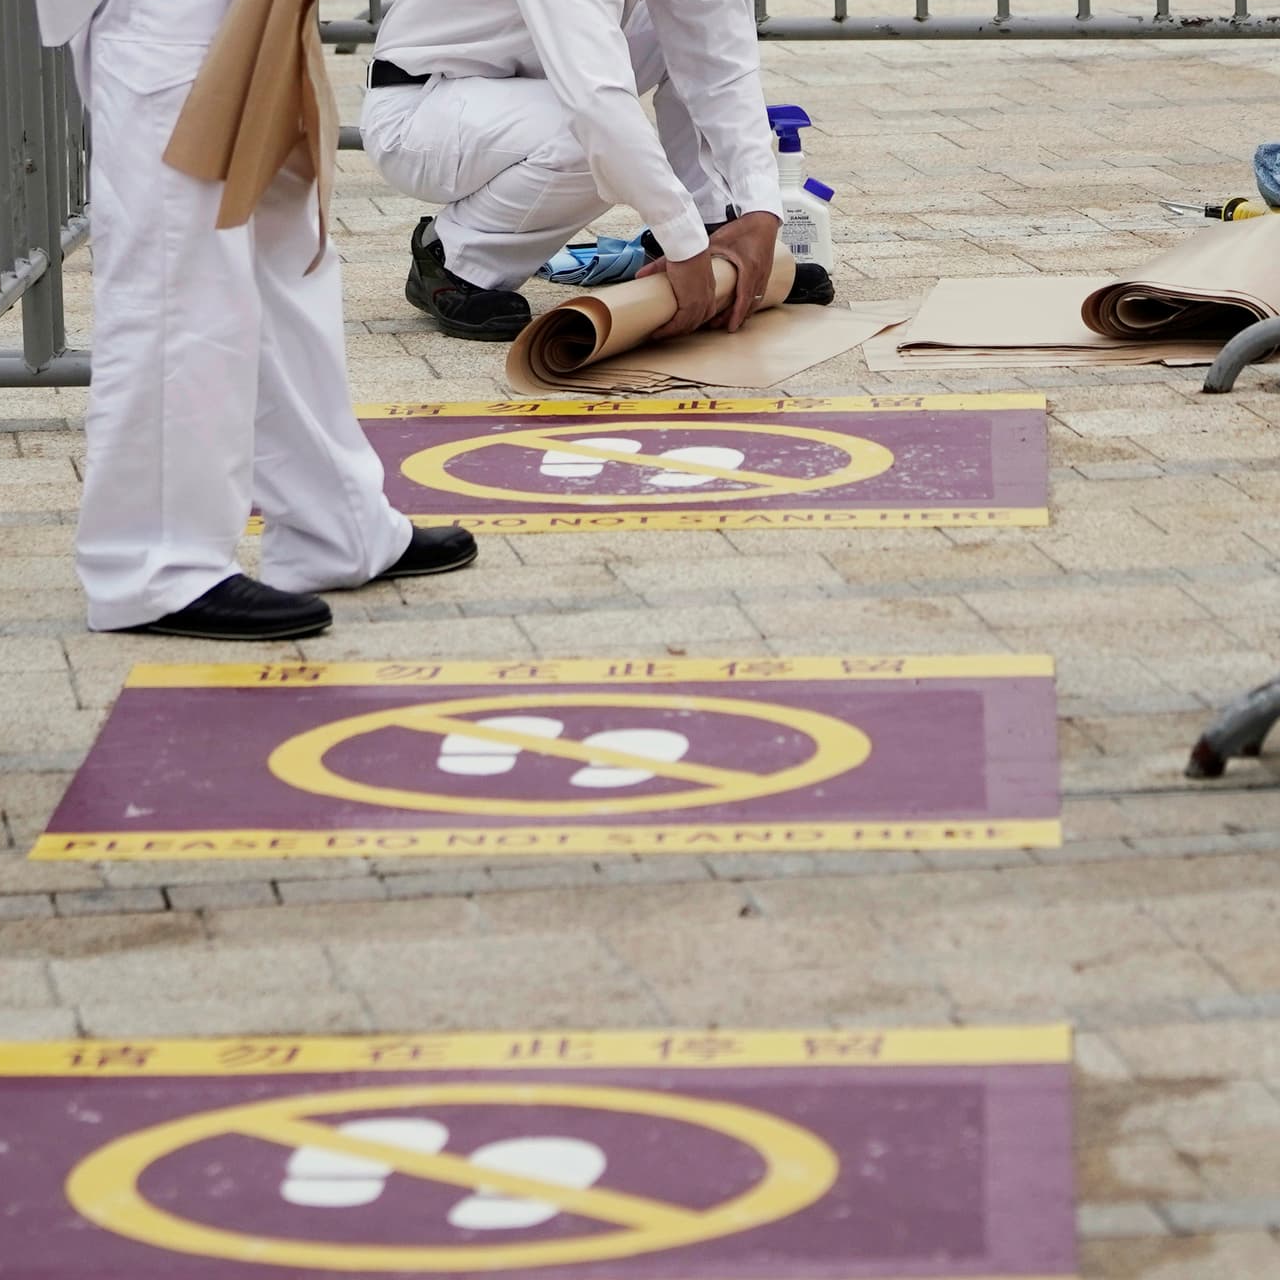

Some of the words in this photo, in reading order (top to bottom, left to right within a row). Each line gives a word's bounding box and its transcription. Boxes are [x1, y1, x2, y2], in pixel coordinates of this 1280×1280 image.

[383, 396, 925, 416] 请勿在此停留
[549, 515, 661, 527] NOT
[678, 513, 857, 524] STAND
[879, 511, 1012, 521] HERE
[256, 659, 907, 681] 请勿在此停留
[64, 836, 299, 852] PLEASE
[326, 834, 419, 849] DO
[447, 831, 580, 847] NOT
[606, 830, 825, 845] STAND
[852, 825, 1010, 840] HERE
[68, 1034, 886, 1069] 请勿在此停留
